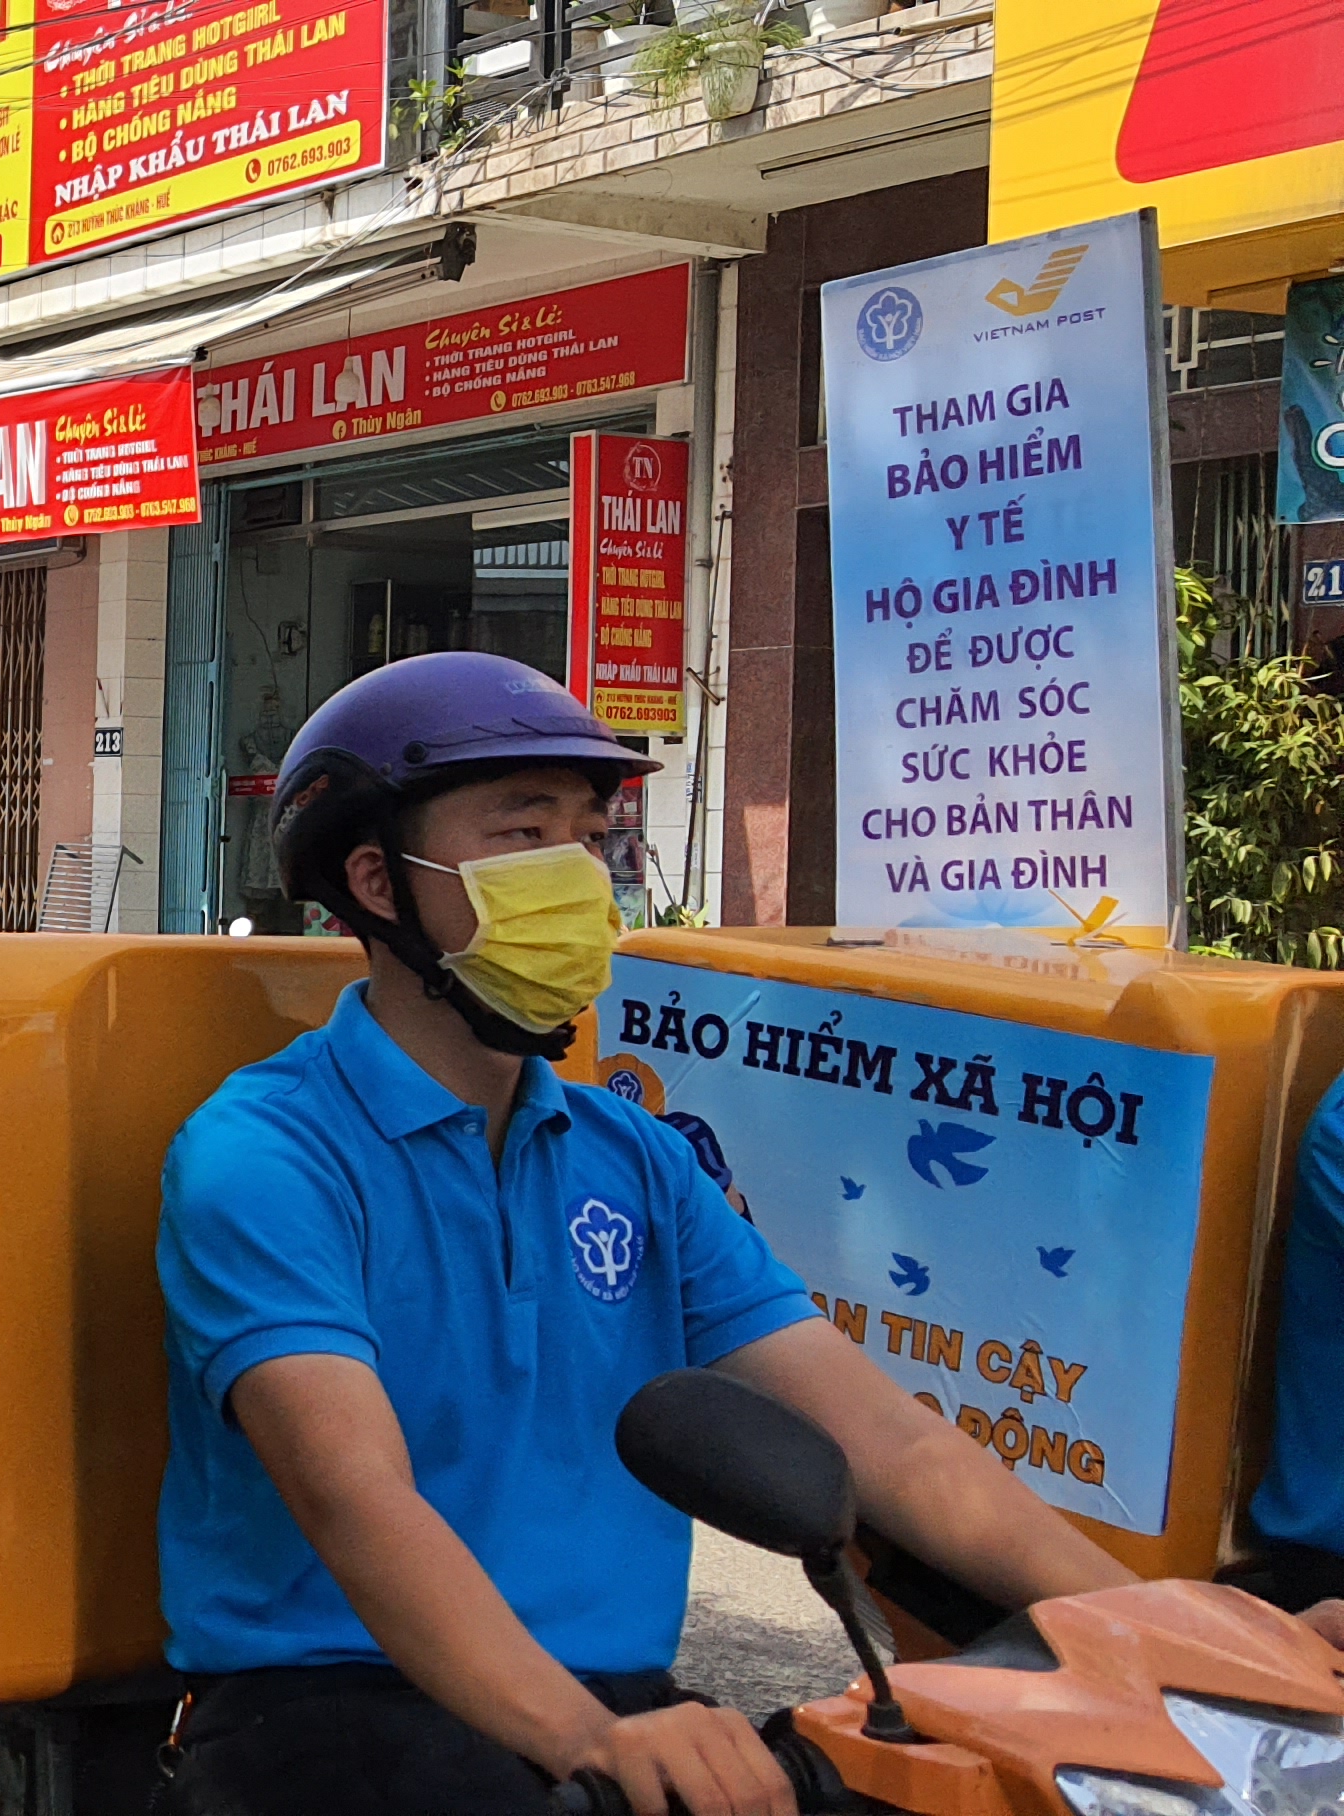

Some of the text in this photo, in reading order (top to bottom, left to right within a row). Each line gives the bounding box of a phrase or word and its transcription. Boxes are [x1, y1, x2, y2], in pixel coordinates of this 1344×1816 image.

[121, 36, 186, 74] TRANG
[192, 1, 281, 50] HOTGIRL
[72, 11, 346, 130] HÀNG TIÊU DÙNG THÁI LAN
[54, 90, 350, 207] NHẬP KHẨU THÁI LAN
[71, 131, 98, 168] BỘ
[103, 109, 170, 152] CHỐNG
[267, 137, 351, 177] 0762.693.903
[425, 322, 491, 349] Chuyên
[468, 328, 576, 360] TRANG HOTGIRL
[973, 306, 1107, 343] VIETNAM POST
[312, 346, 405, 418] LAN
[433, 365, 470, 382] HÀNG
[589, 335, 619, 352] LAN
[55, 413, 100, 445] Chuyên
[893, 376, 1071, 439] THAM GIA
[633, 457, 653, 478] TN
[886, 424, 1083, 500] BẢO HIỂM
[602, 490, 681, 534] THÁI LAN
[946, 493, 1026, 552] Y TẾ
[865, 556, 1118, 630] HỘ GIA ĐÌNH
[907, 624, 1075, 677] ĐỂ ĐƯỢC
[895, 680, 1091, 730] CHĂM SÓC
[95, 731, 122, 754] 213
[901, 730, 1088, 785] SỨC KHỎE
[861, 789, 1133, 842] CHO BẢN THÂN
[885, 851, 1108, 895] VÀ GIA ĐÌNH
[619, 990, 1145, 1149] BẢO HIỂM XÃ HỘI
[880, 1311, 1088, 1405] TIN CẬY
